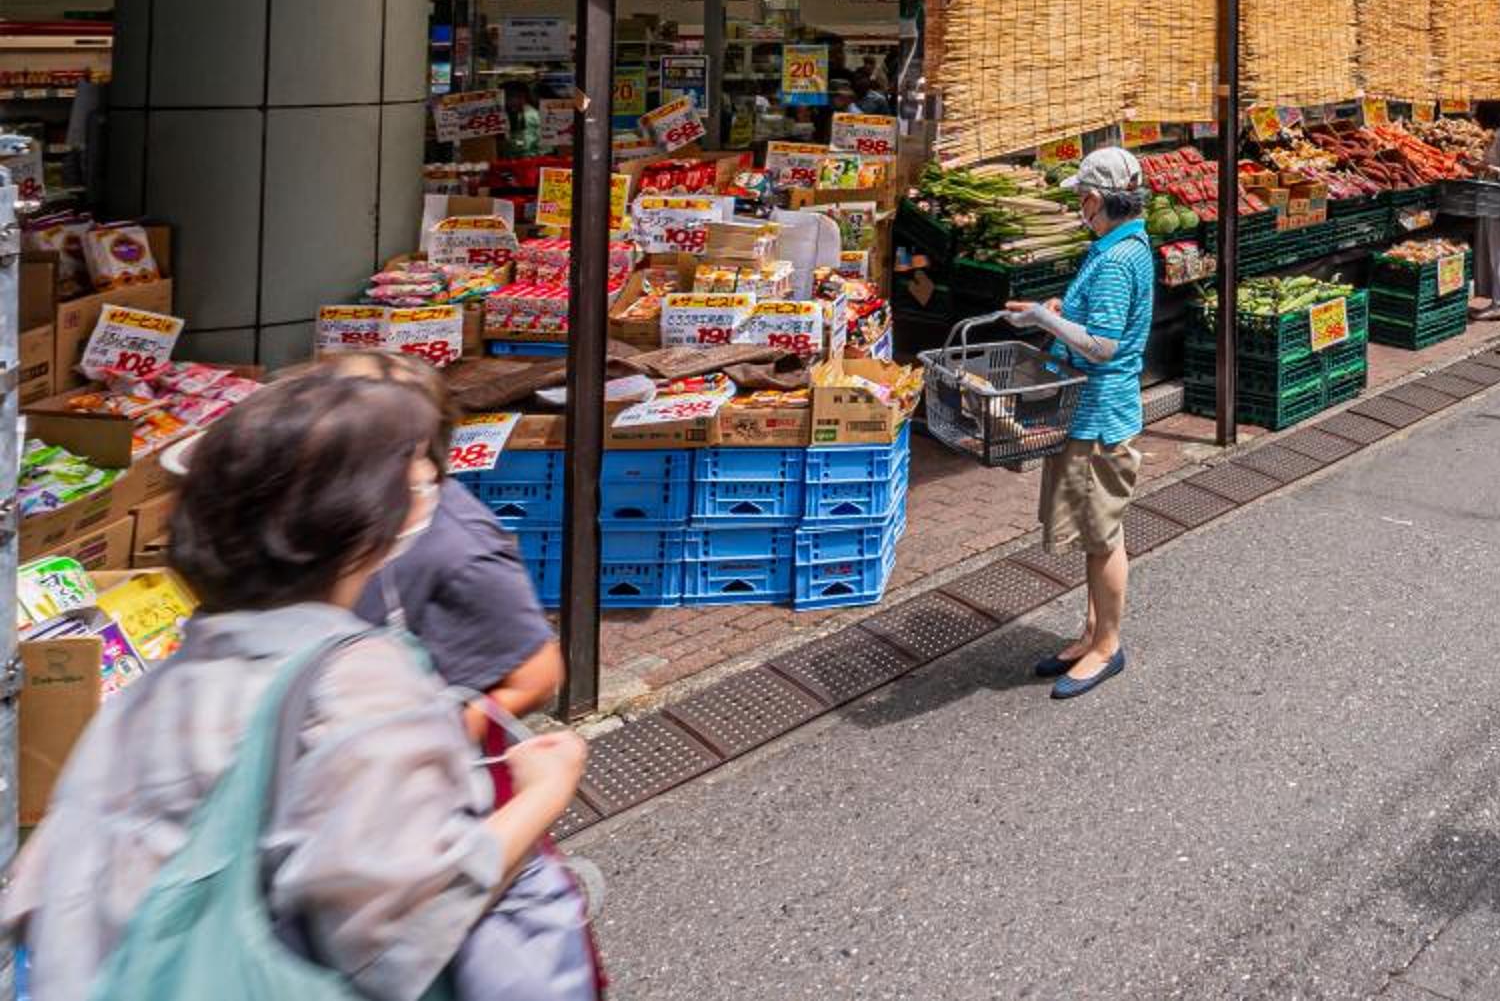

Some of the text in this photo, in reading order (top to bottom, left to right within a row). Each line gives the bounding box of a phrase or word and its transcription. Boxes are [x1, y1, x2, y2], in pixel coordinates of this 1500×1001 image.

[790, 61, 815, 78] 20
[857, 138, 890, 155] 198
[664, 228, 706, 244] 108
[468, 248, 512, 266] 158
[768, 333, 812, 354] 198
[115, 350, 156, 377] 108
